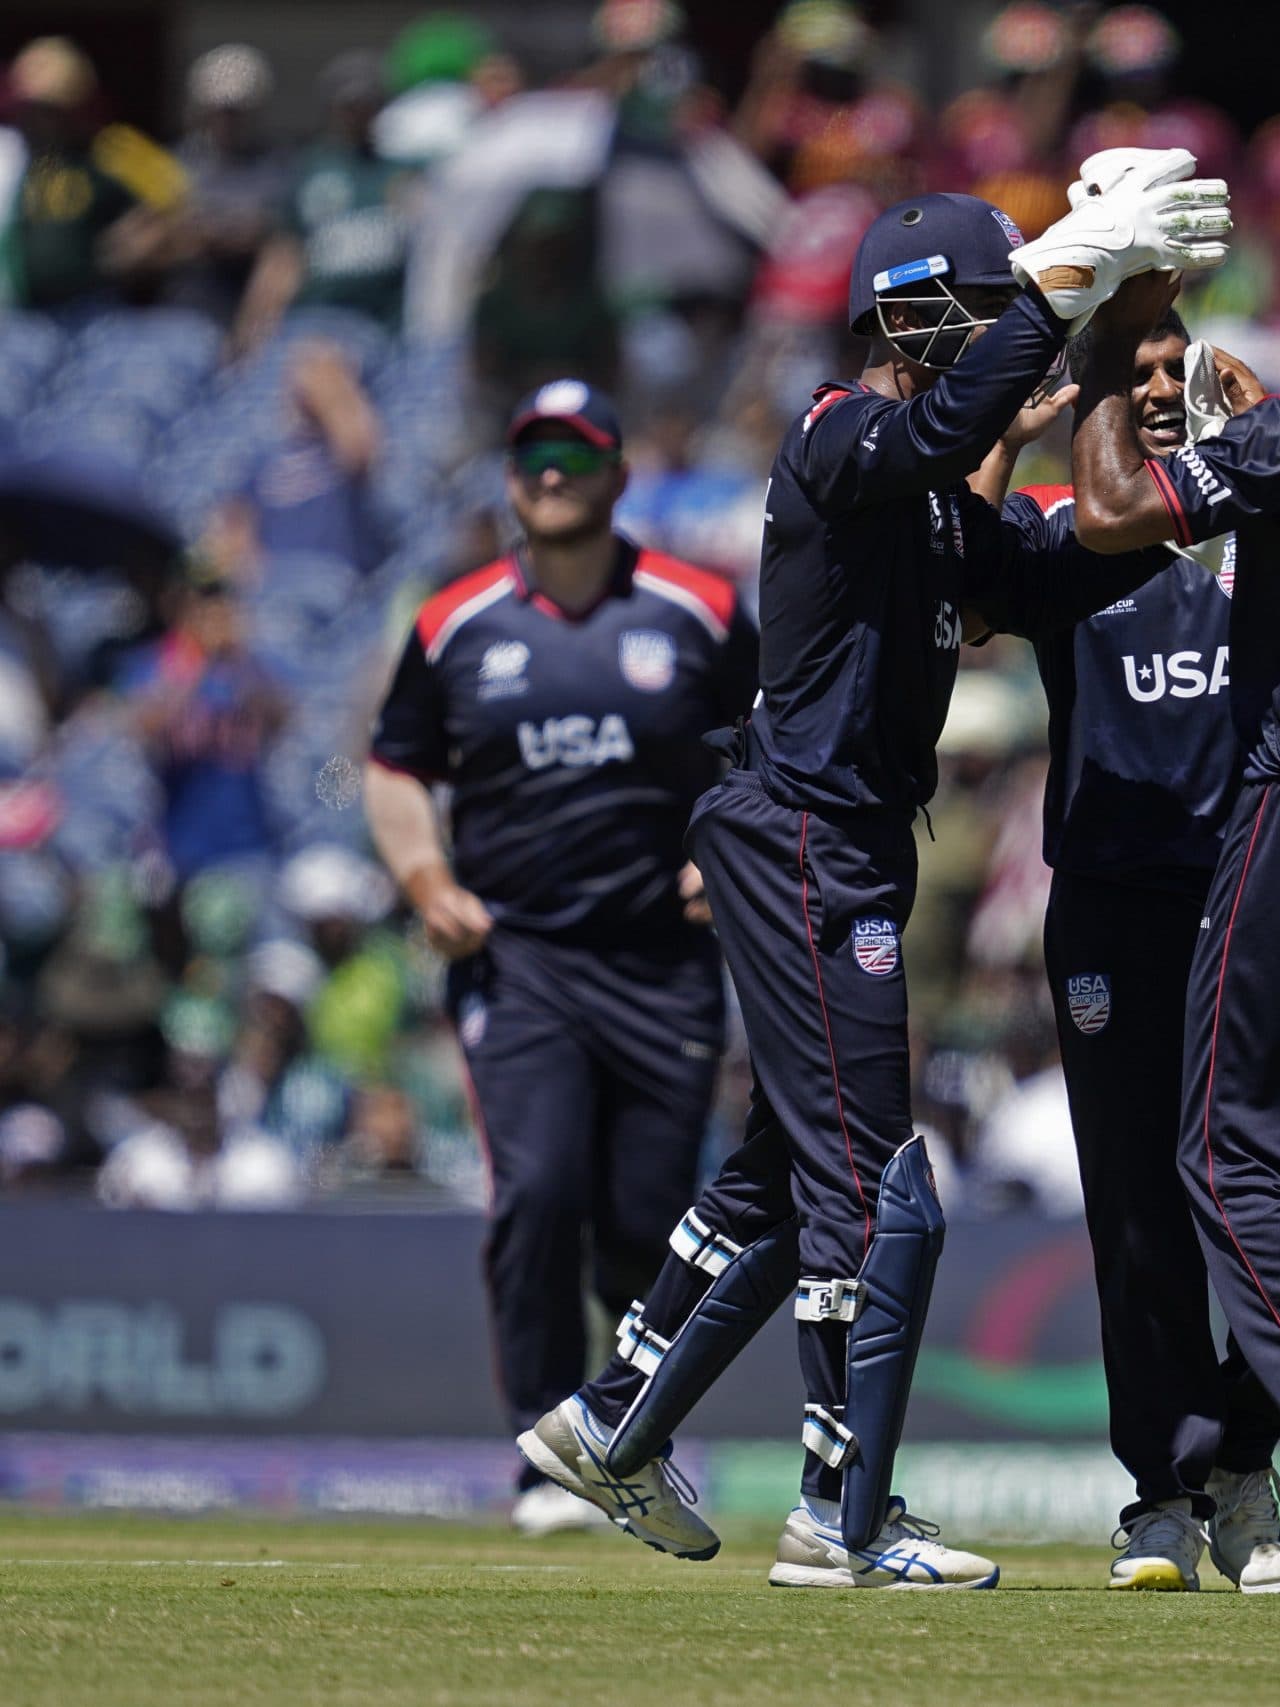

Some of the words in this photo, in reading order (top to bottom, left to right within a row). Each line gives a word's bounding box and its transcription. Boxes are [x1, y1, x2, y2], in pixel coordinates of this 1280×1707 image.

[1116, 600, 1135, 608] CUP
[517, 713, 635, 770] USA
[855, 919, 893, 935] USA
[1068, 976, 1107, 995] USA
[1069, 994, 1108, 1006] CRICKET
